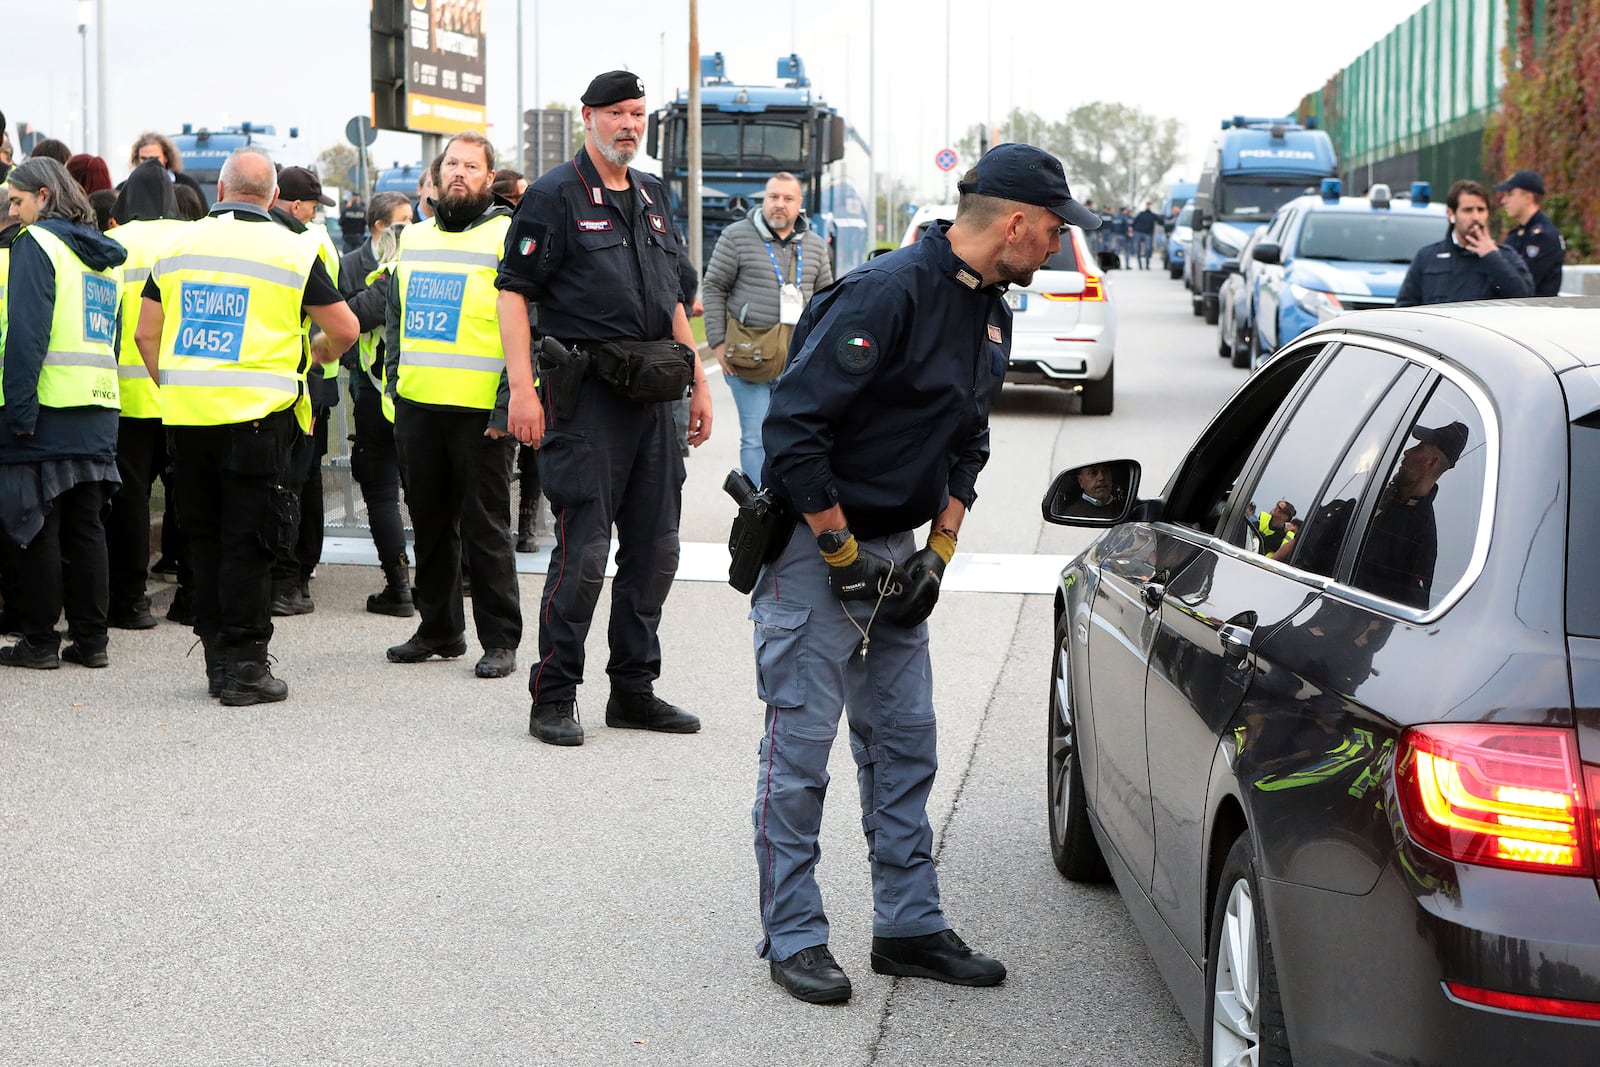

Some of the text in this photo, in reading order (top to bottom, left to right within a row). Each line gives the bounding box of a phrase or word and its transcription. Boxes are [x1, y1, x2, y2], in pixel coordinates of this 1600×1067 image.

[1238, 149, 1315, 160] POLIZIA
[408, 276, 462, 302] STEWARD
[184, 289, 245, 317] STEWARD
[407, 310, 448, 332] 0512
[182, 327, 234, 353] 0452
